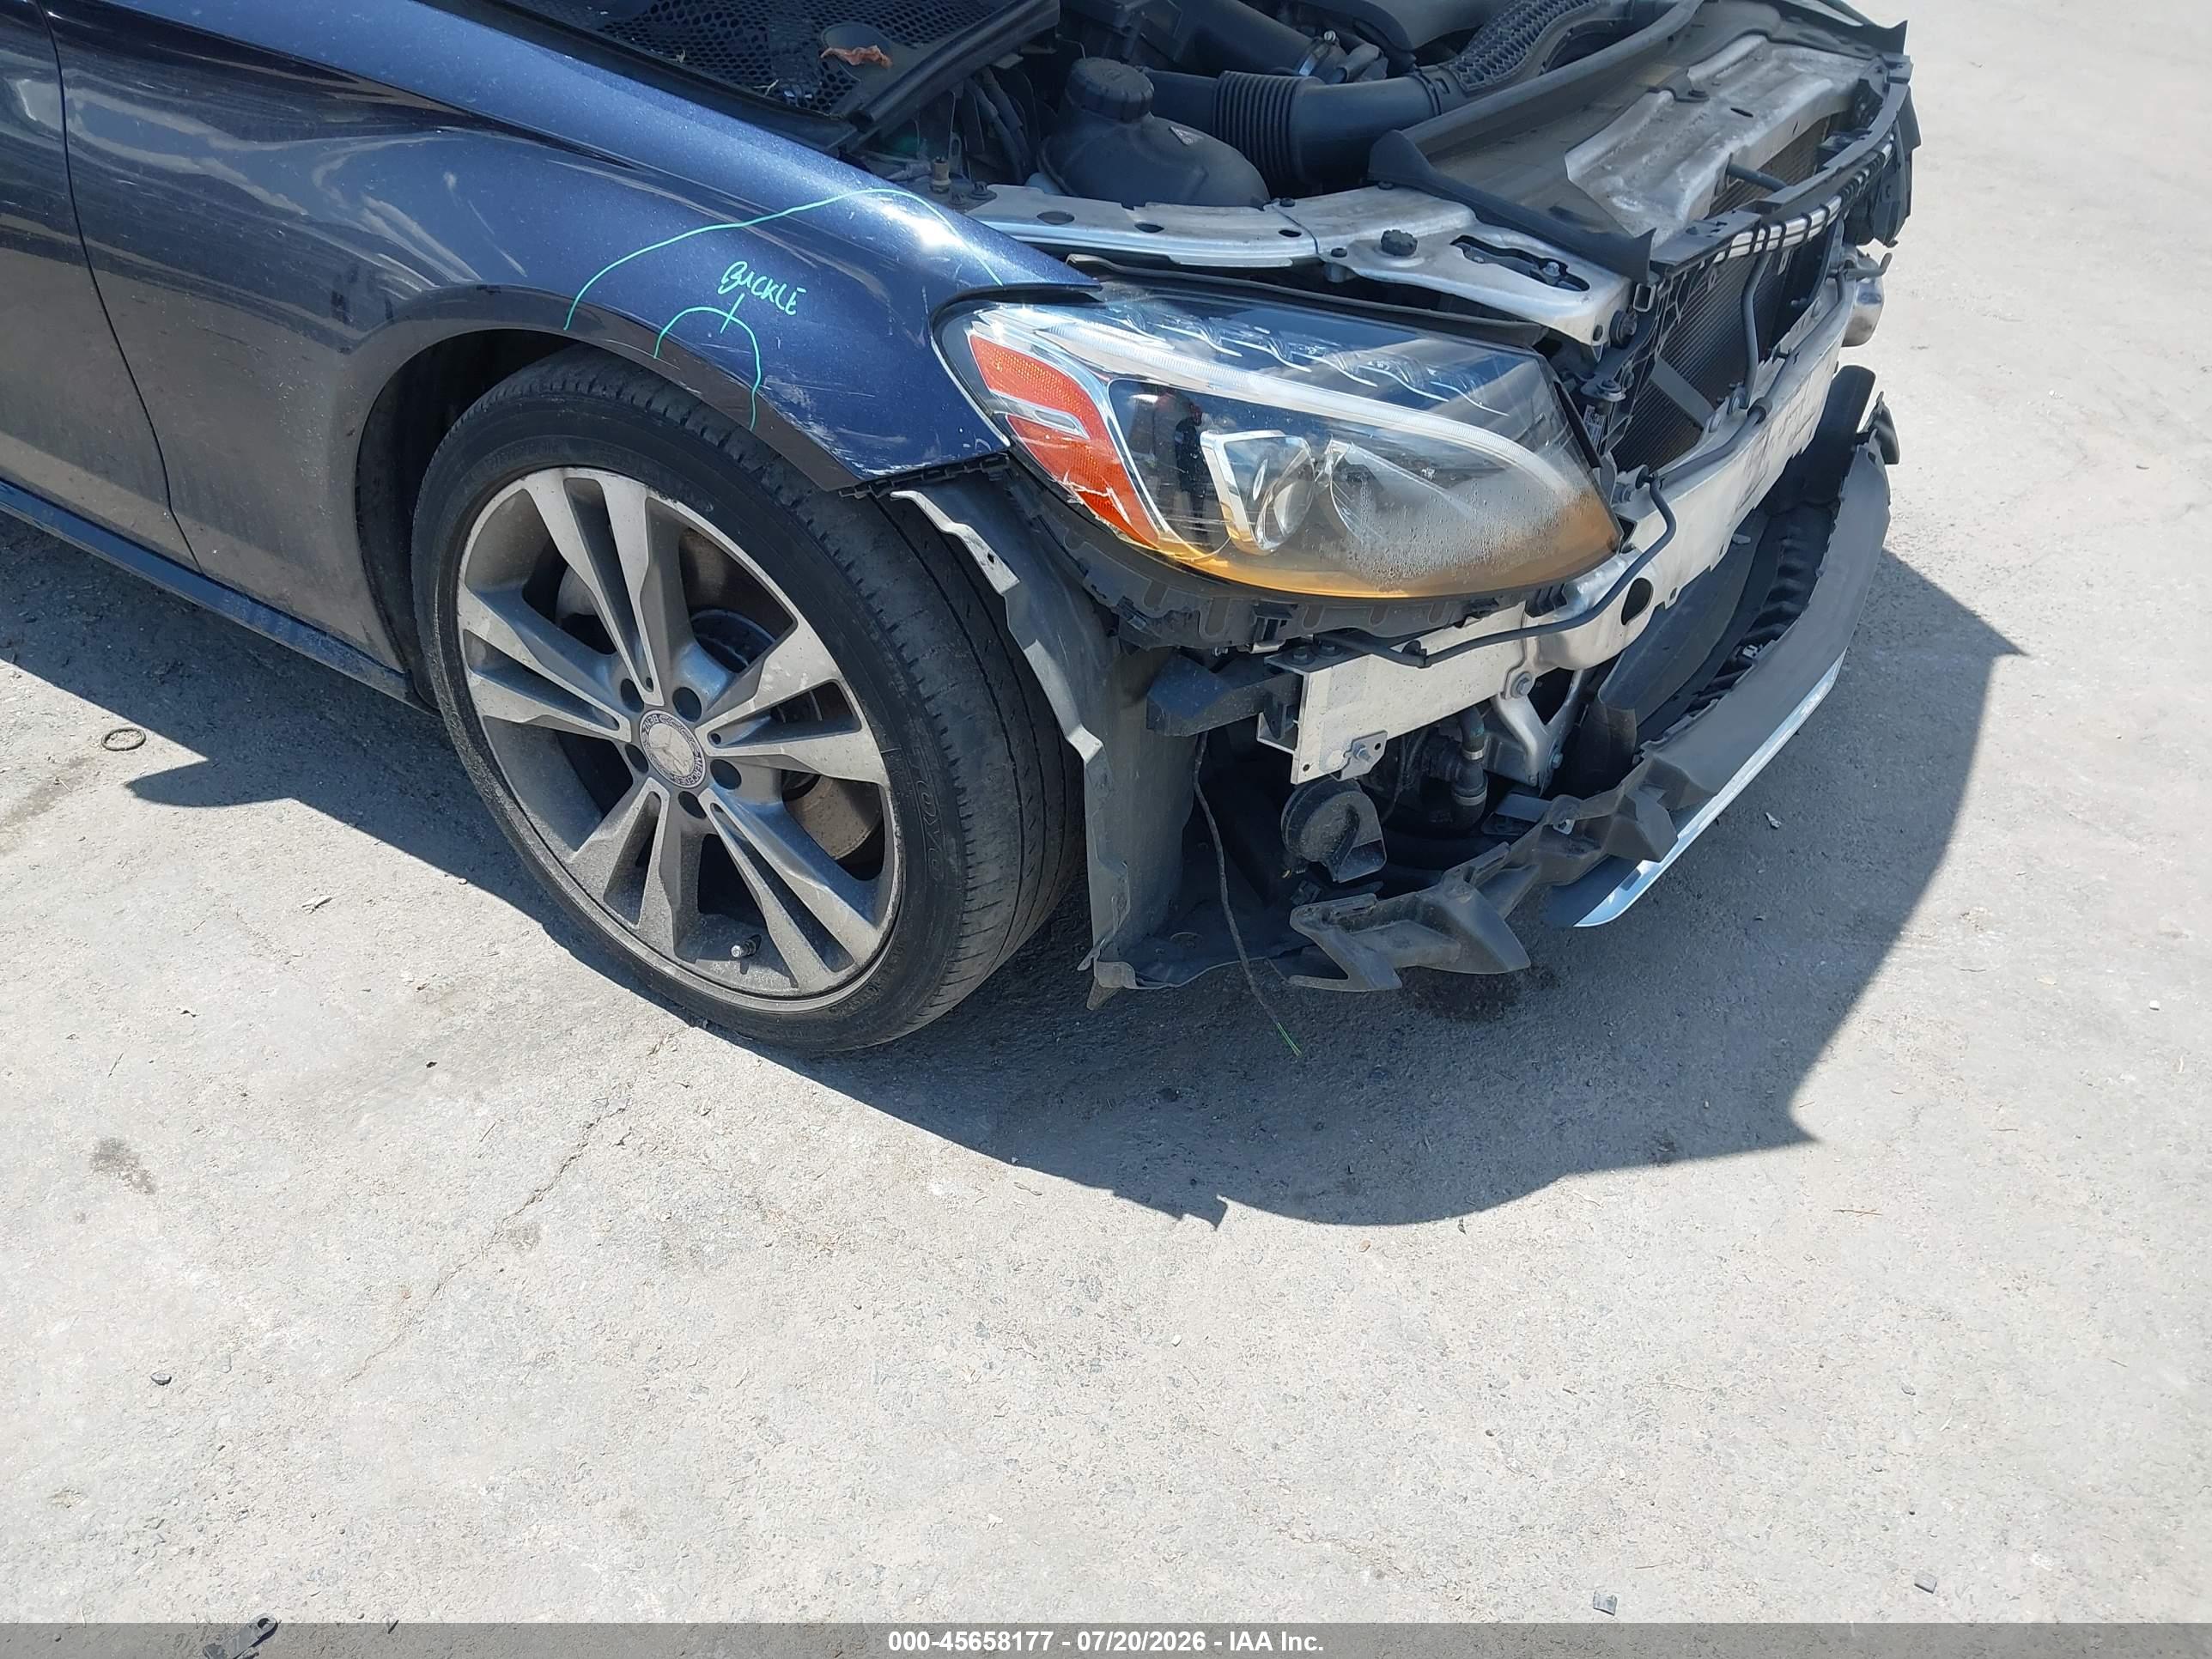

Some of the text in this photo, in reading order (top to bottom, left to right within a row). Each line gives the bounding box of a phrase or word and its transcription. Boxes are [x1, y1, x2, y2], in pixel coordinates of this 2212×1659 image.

[717, 260, 807, 316] BUCKLE
[642, 714, 659, 732] BENZ
[674, 757, 702, 785] MERCEDES
